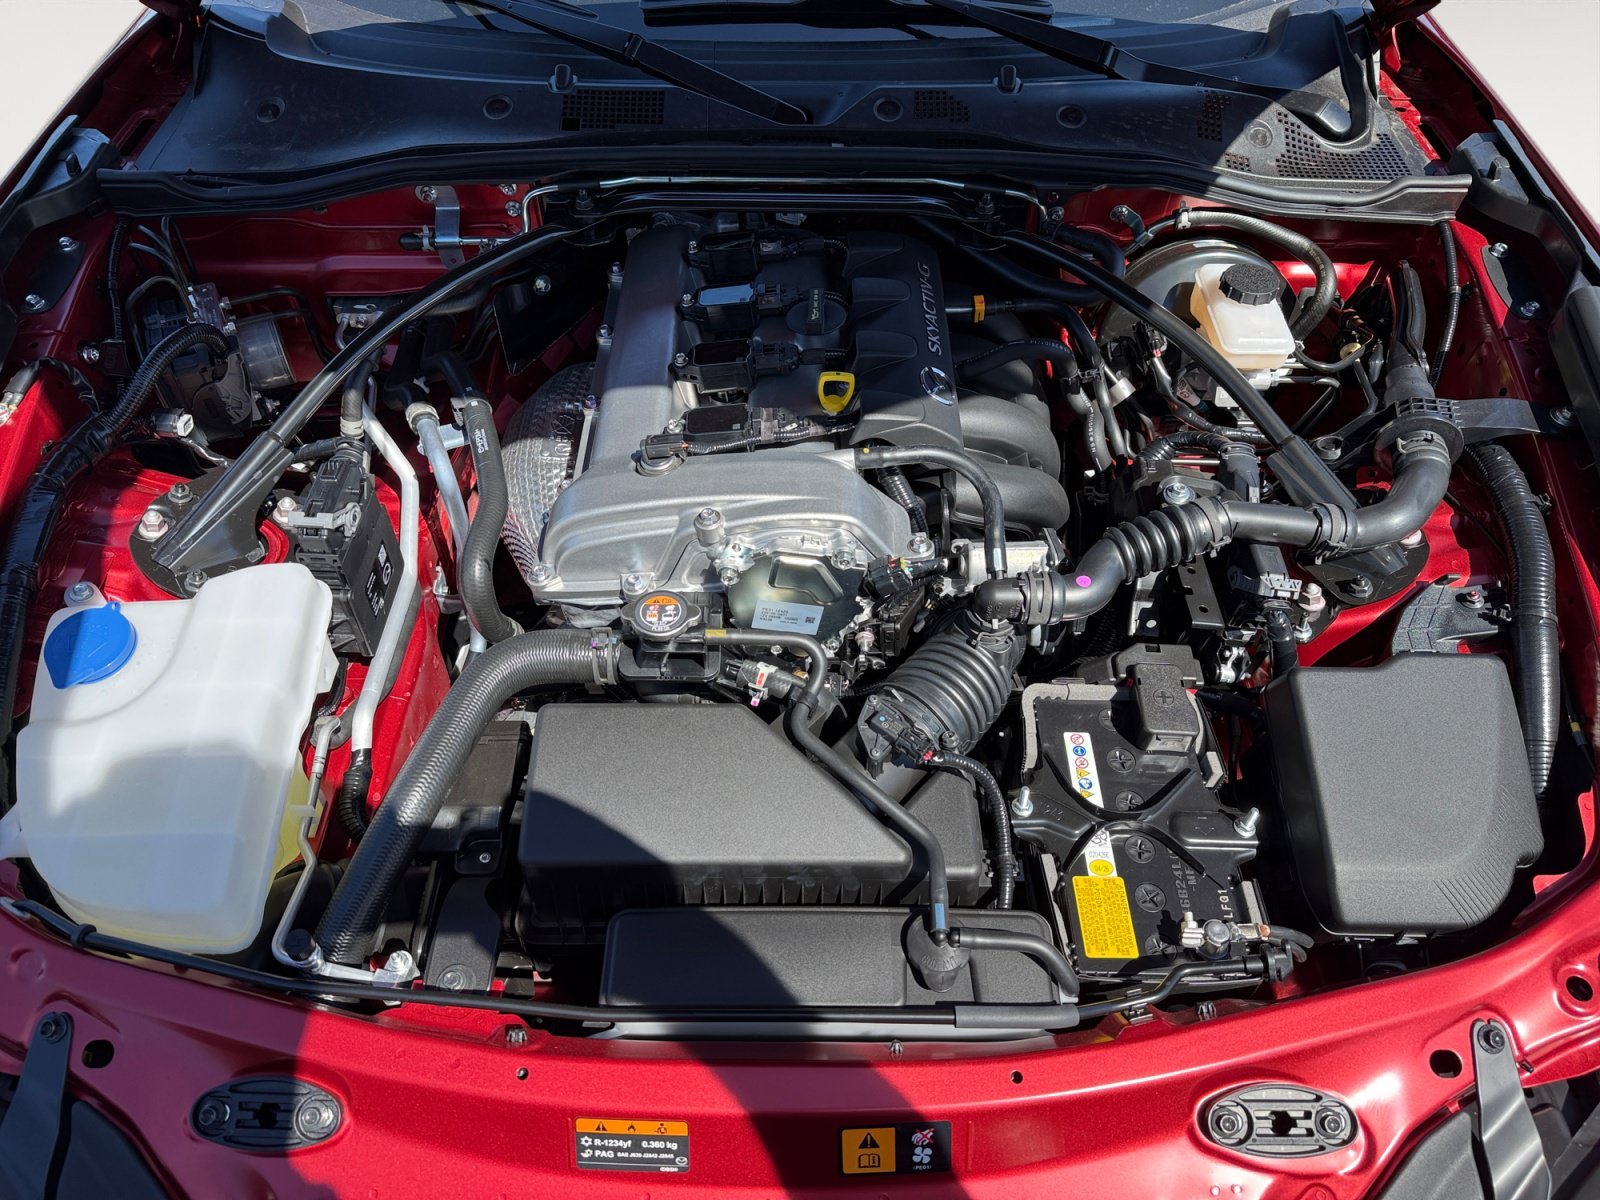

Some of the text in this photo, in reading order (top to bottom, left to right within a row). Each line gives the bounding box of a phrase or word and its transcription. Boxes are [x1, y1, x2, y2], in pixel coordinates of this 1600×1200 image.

[917, 261, 942, 356] SKYACTIV-G
[594, 1139, 678, 1150] R-1234yf 0.360 kg
[594, 1150, 615, 1158] PAG
